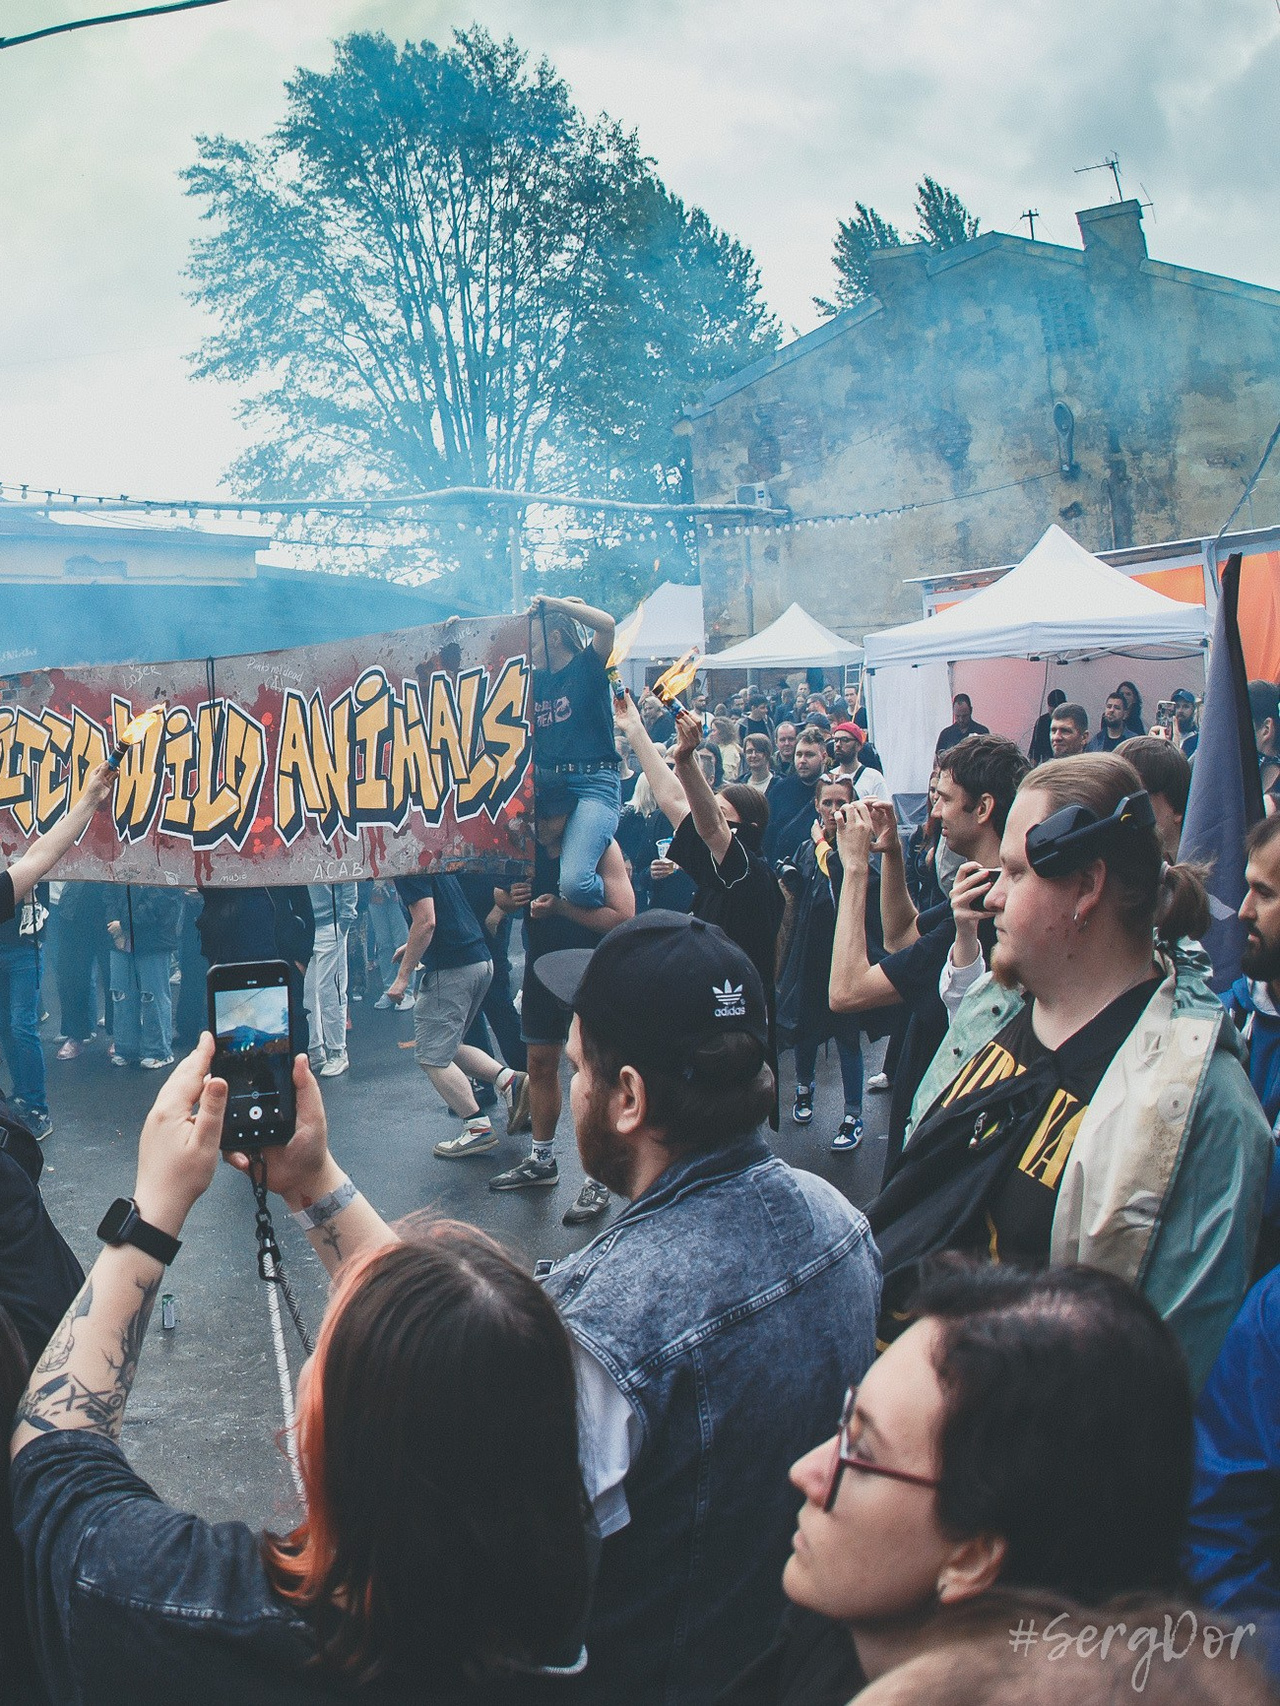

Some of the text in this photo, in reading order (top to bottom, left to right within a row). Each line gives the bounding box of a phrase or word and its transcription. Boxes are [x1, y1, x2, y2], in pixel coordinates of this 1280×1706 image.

[111, 693, 267, 852] WILD
[274, 654, 533, 848] ANIMALS
[714, 1006, 746, 1017] adidas
